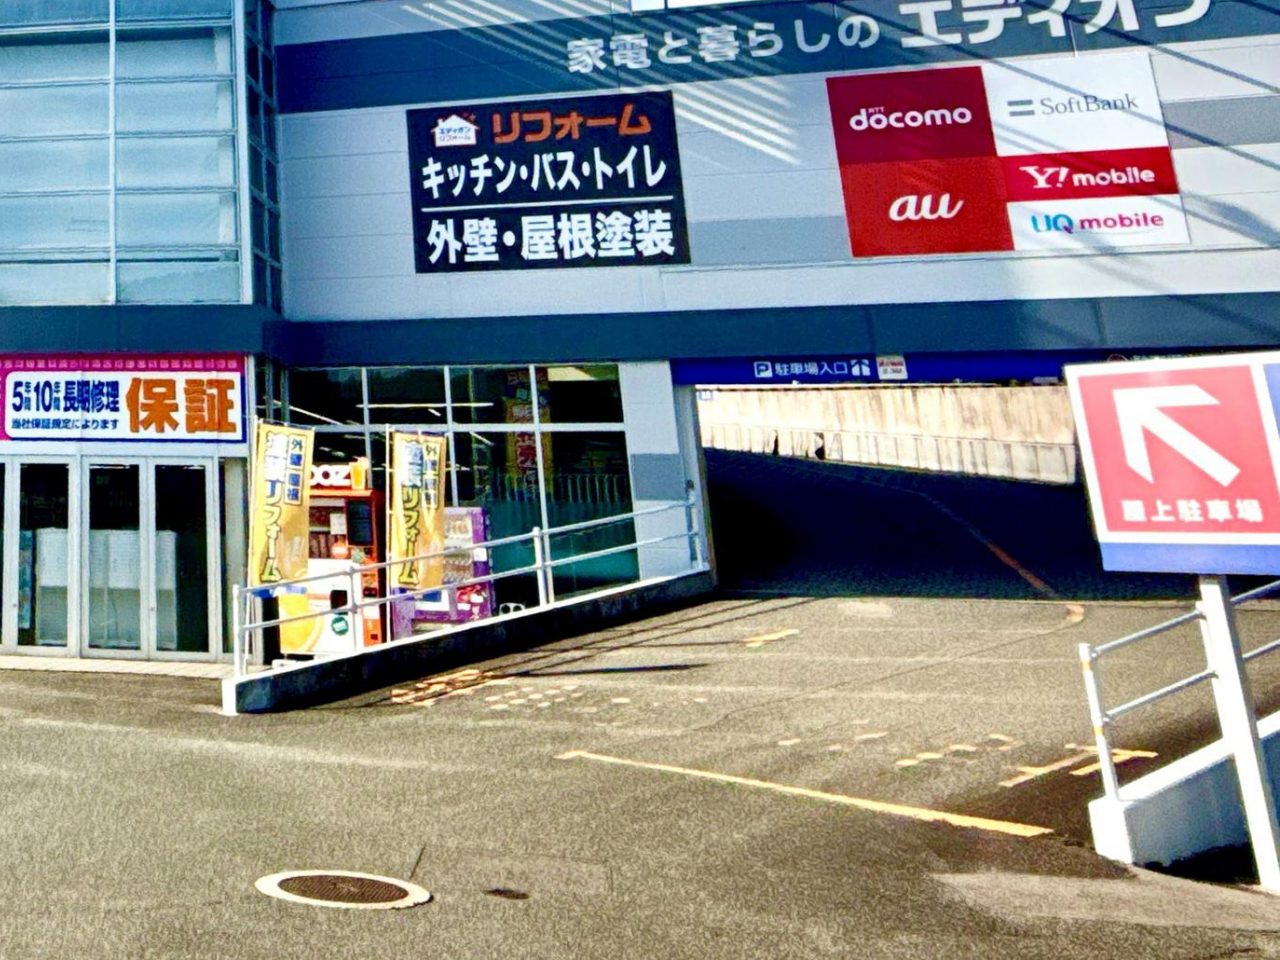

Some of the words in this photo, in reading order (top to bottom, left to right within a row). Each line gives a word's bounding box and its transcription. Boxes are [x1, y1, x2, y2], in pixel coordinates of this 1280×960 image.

[567, 12, 881, 74] 家電と暮らしの
[849, 106, 973, 131] docomo
[1041, 93, 1139, 116] SoftBank
[492, 102, 652, 144] リフォーム
[422, 144, 667, 199] キッチン・バス・トイレ
[1072, 166, 1156, 188] mobile
[888, 192, 964, 222] au
[426, 209, 675, 265] 外壁・屋根塗装
[1031, 213, 1075, 234] UQ
[1079, 213, 1165, 230] mobile
[774, 362, 848, 376] 駐車場入口
[125, 377, 238, 434] 保証
